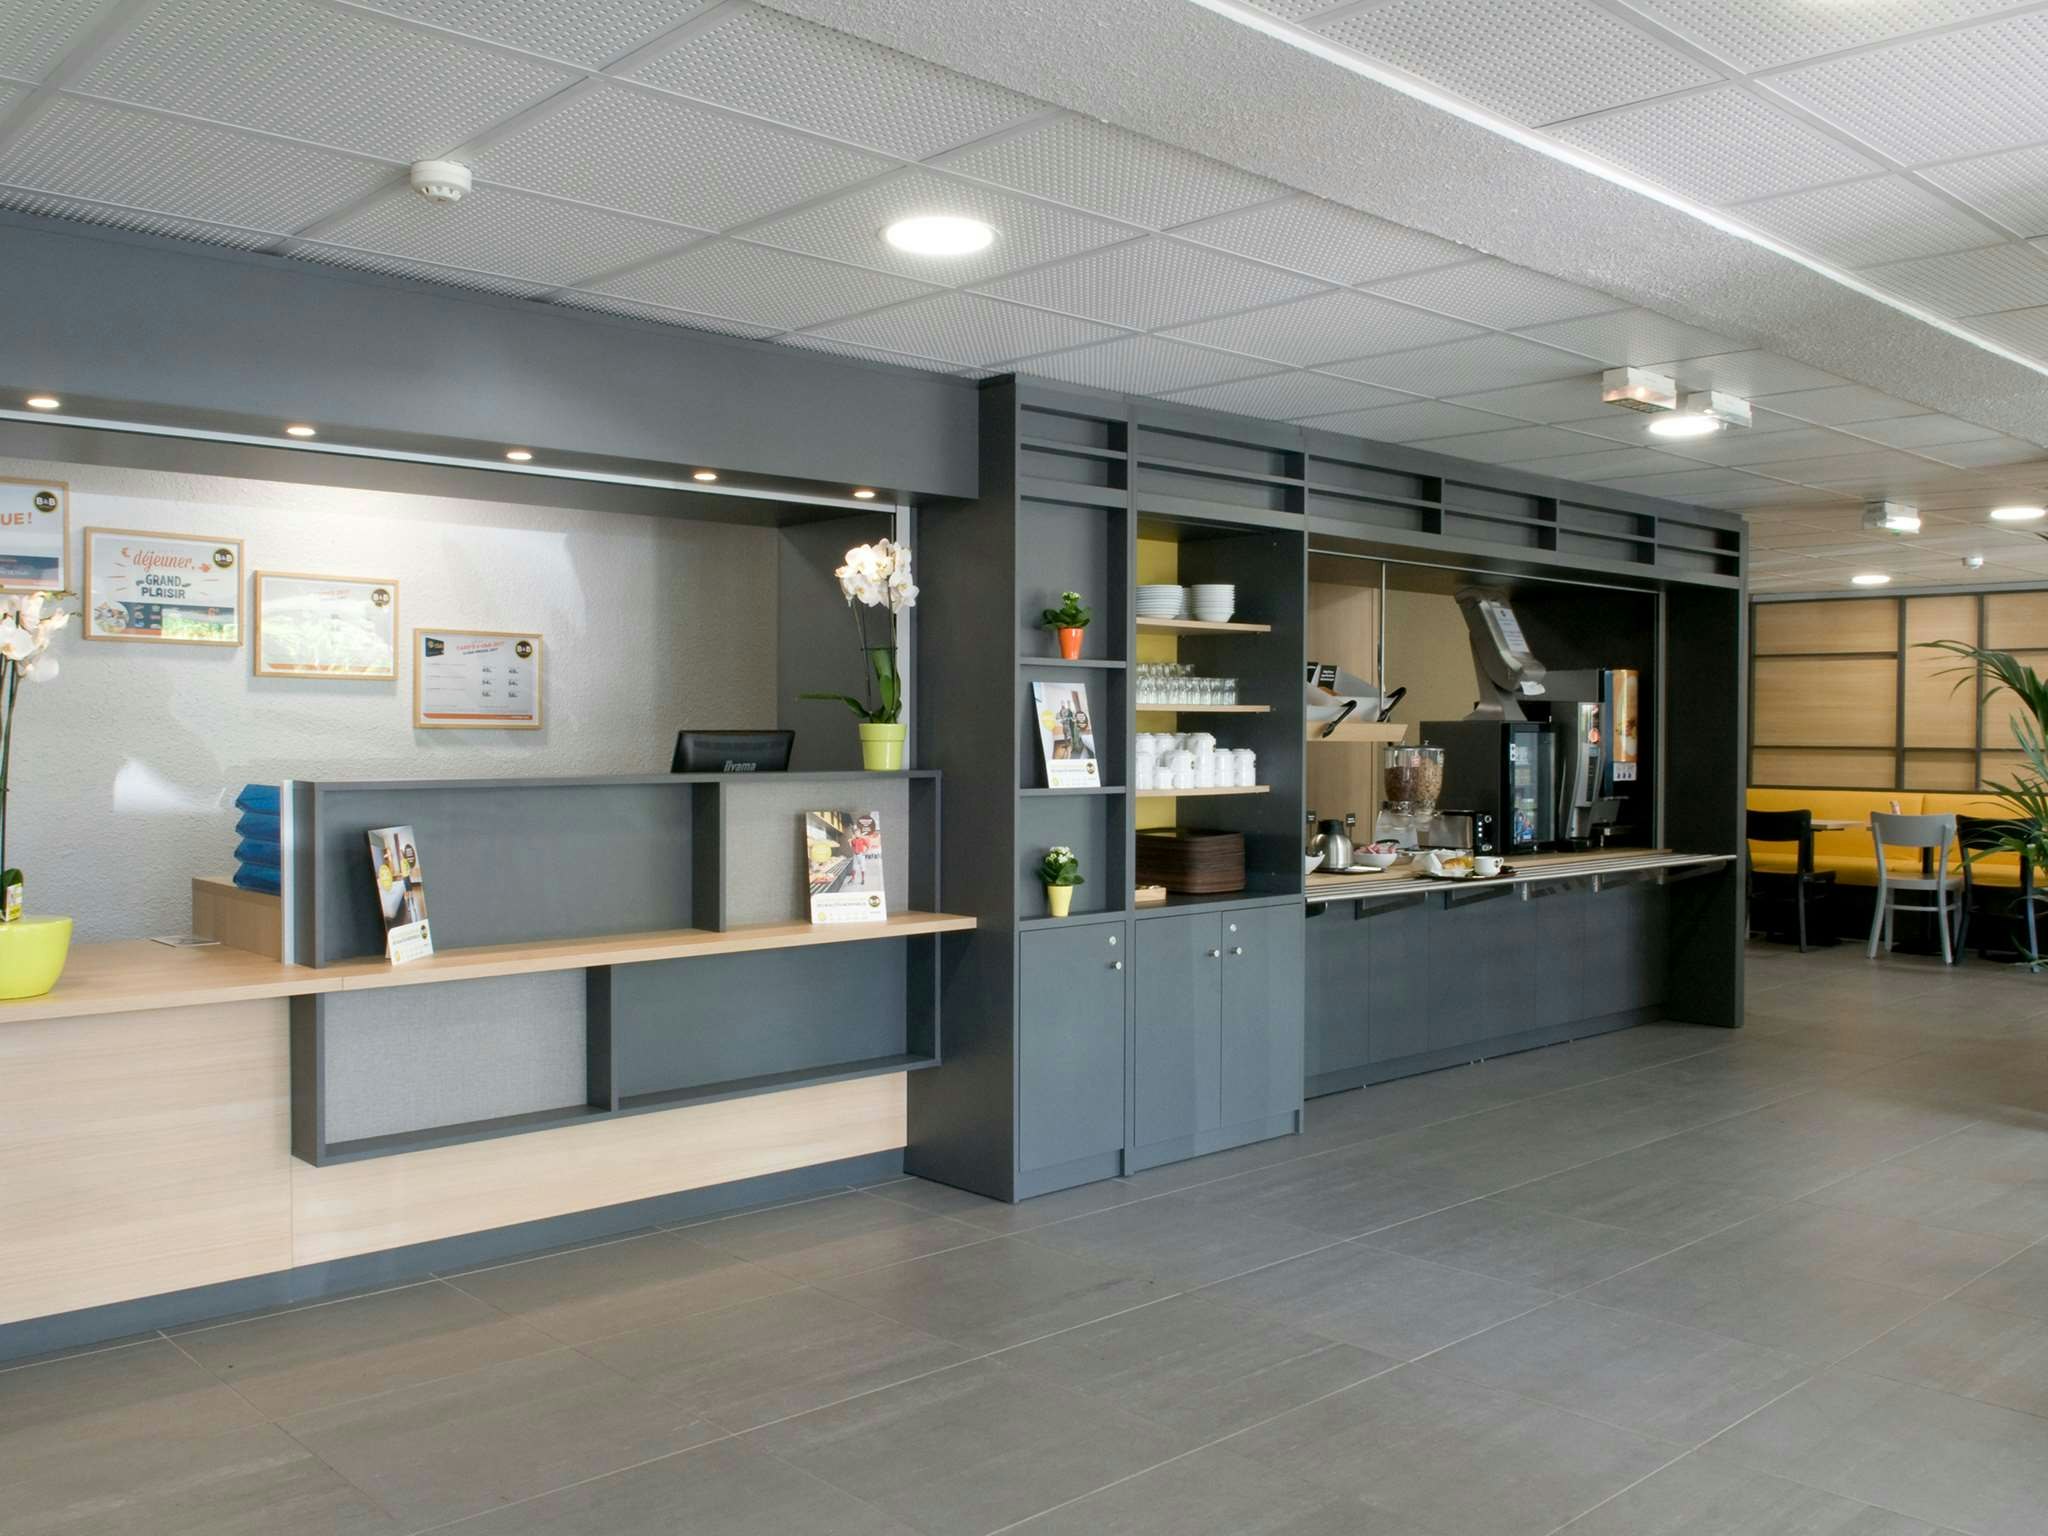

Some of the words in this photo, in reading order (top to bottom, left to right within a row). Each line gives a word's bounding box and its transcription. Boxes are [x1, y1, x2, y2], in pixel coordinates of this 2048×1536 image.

[36, 497, 56, 506] B&B
[145, 574, 182, 587] GRAND
[141, 587, 186, 599] PLAISIR
